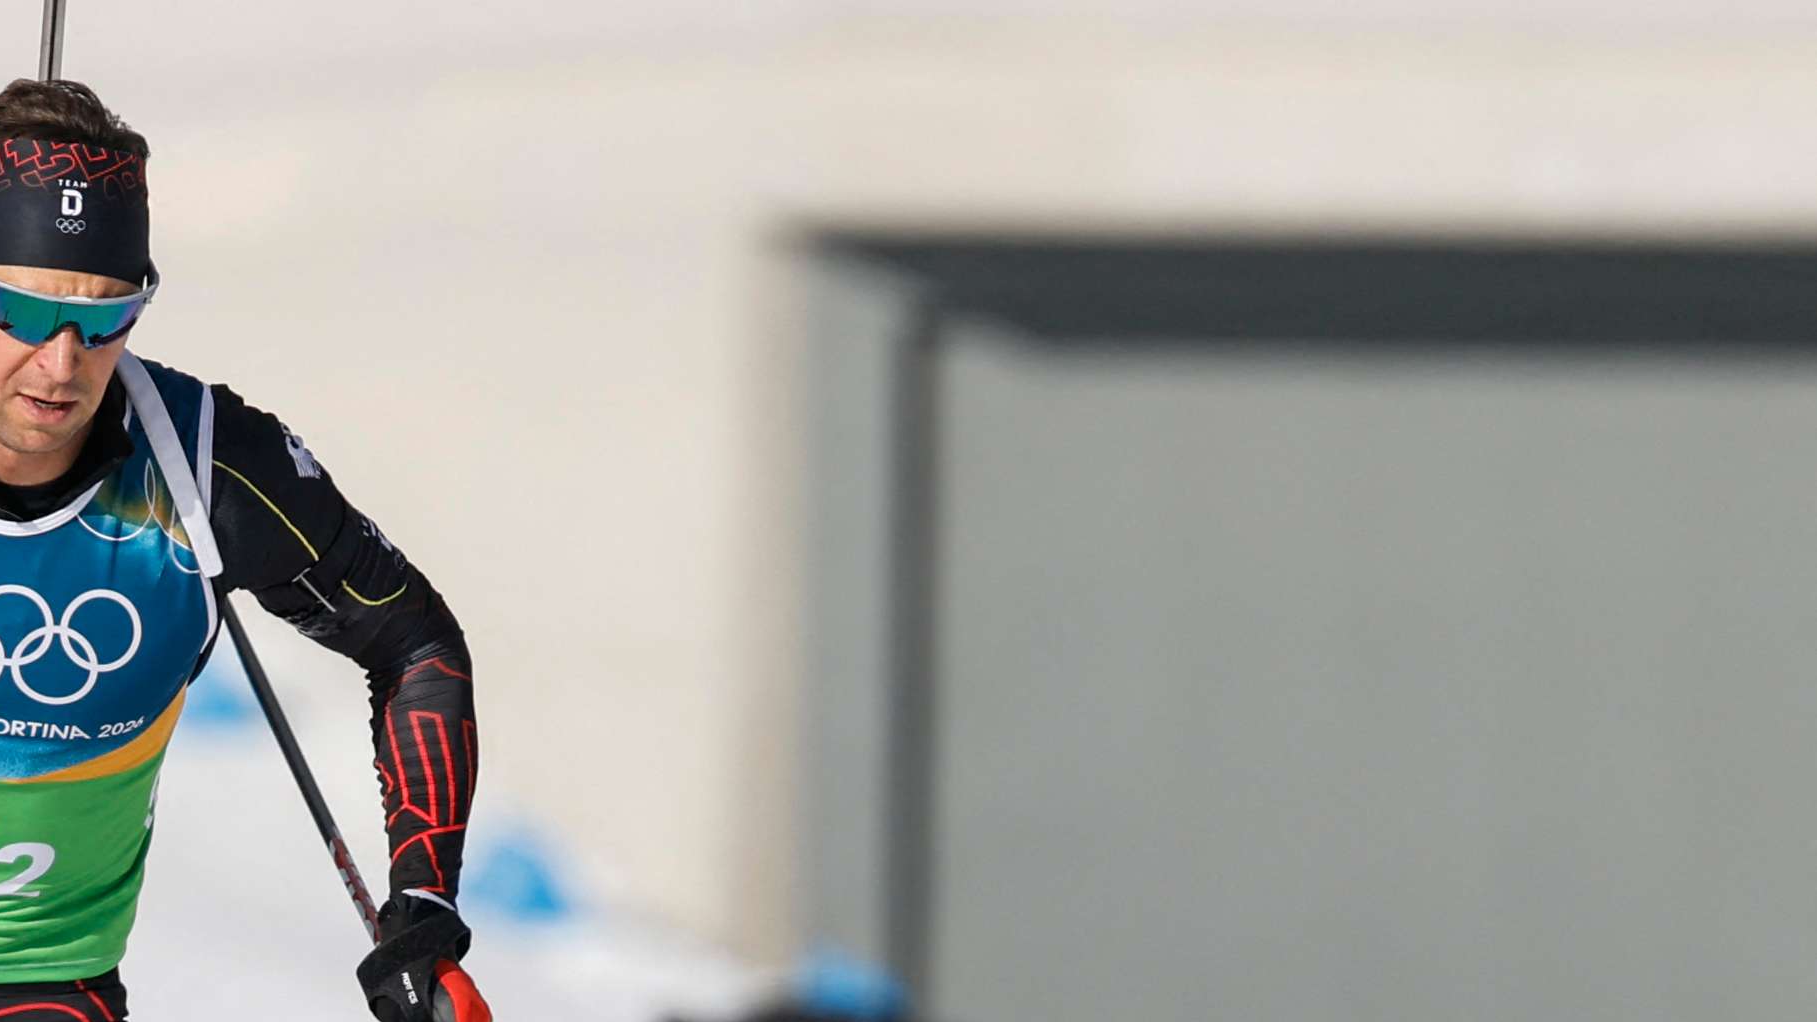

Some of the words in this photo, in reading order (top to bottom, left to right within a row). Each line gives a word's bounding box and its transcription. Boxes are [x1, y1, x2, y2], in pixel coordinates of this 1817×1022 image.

[58, 179, 88, 188] TEAM
[62, 189, 83, 216] D
[97, 716, 145, 739] 2026
